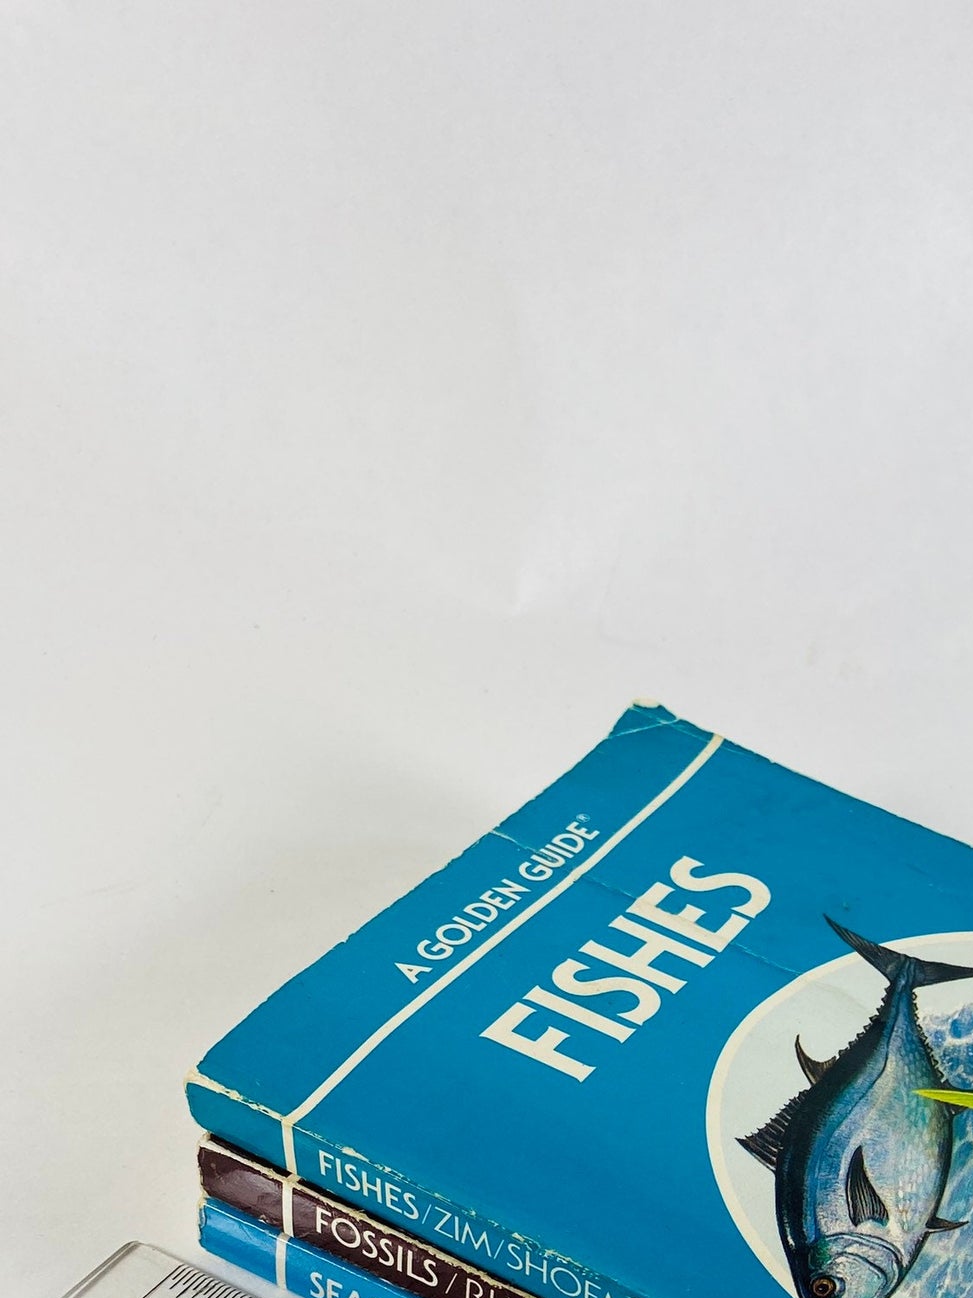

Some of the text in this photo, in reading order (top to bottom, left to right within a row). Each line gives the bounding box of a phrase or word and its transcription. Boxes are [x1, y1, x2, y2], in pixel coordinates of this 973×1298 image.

[394, 961, 433, 984] A
[416, 878, 532, 960] GOLDEN
[479, 855, 771, 1083] FISHES
[315, 1206, 439, 1287] FOSSILS
